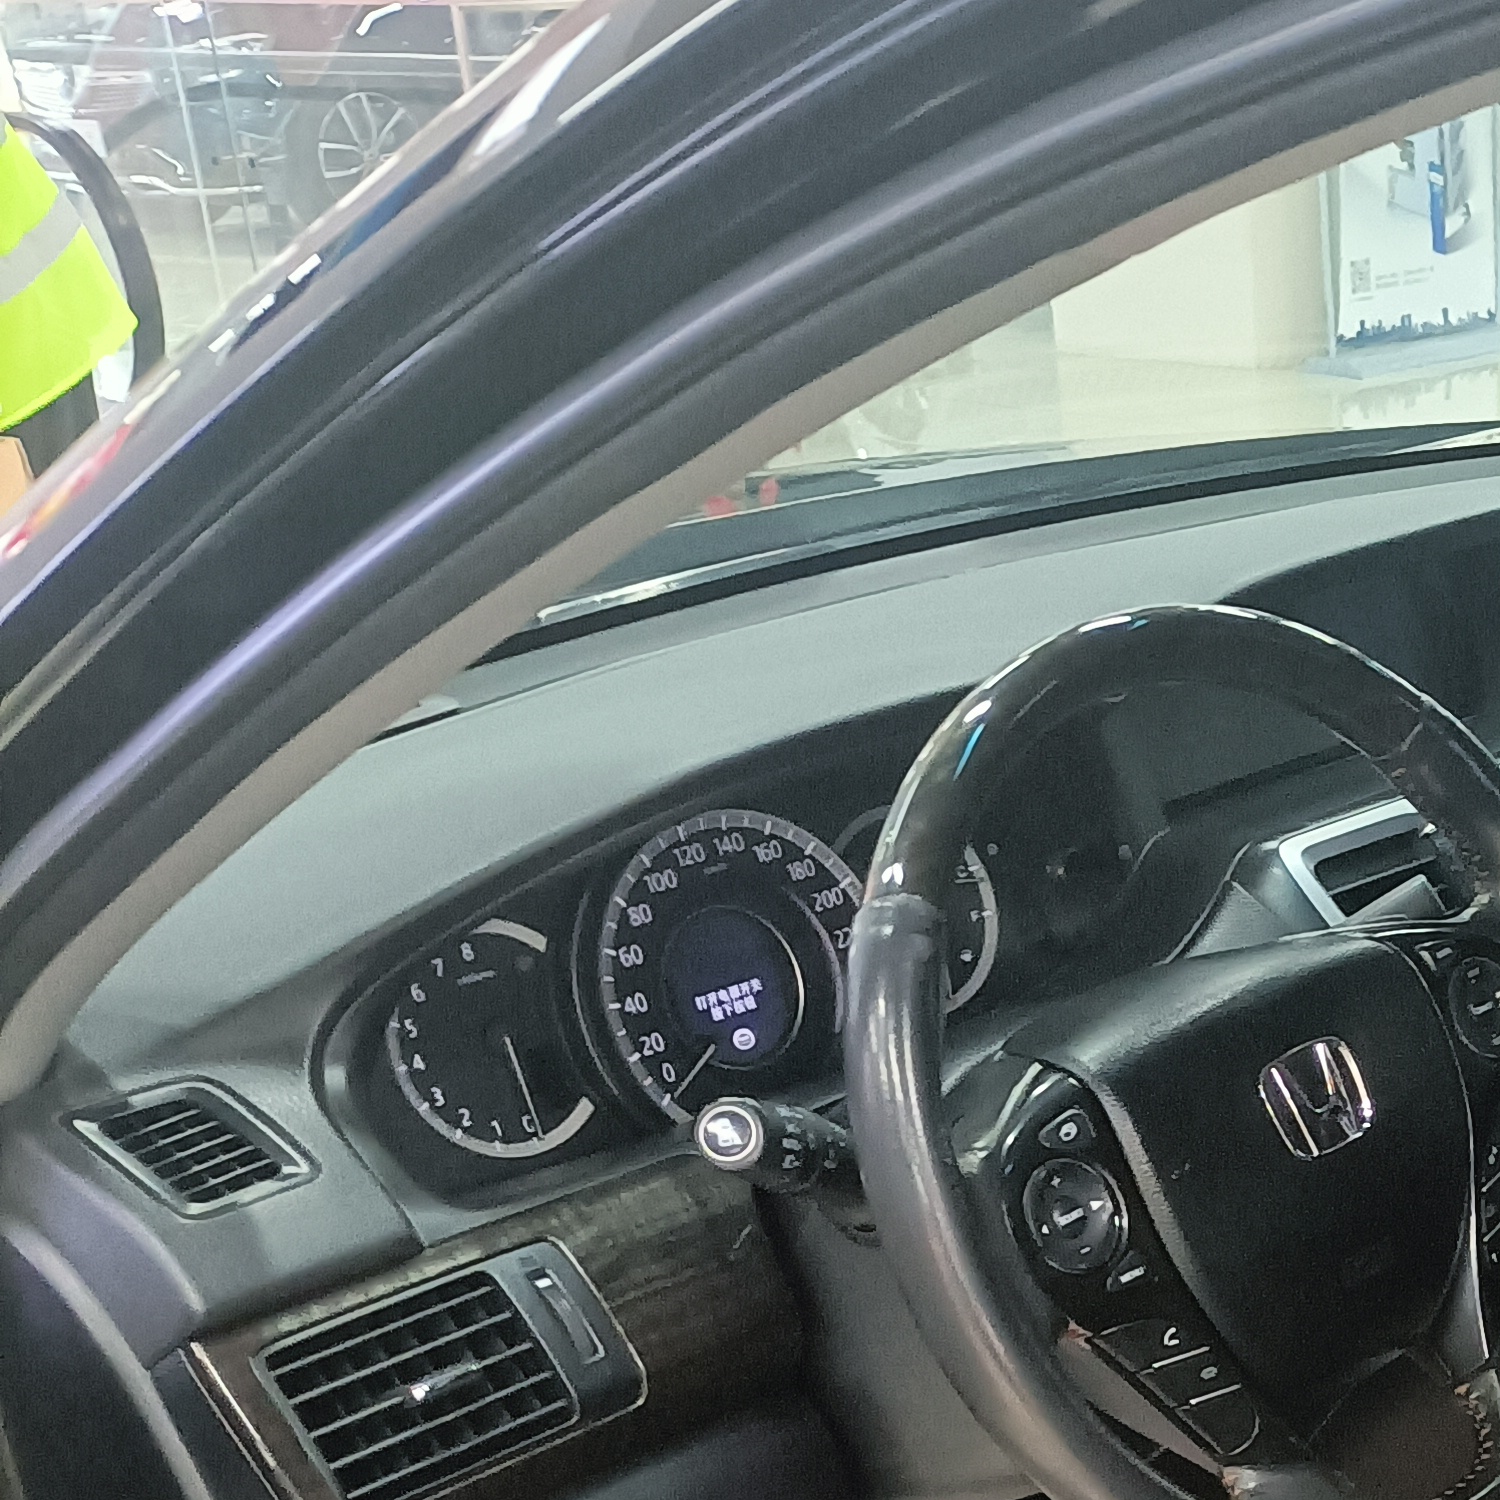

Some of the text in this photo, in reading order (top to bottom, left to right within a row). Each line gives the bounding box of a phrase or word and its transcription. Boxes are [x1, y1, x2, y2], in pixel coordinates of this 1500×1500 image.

[673, 842, 706, 867] 120
[713, 832, 745, 856] 140
[752, 839, 782, 864] 160
[643, 868, 678, 894] 100
[786, 857, 816, 882] 180
[811, 887, 844, 913] 200
[627, 903, 653, 927] 80
[833, 926, 853, 949] 22
[431, 957, 444, 978] 7
[618, 944, 644, 968] 60
[410, 983, 427, 1003] 6
[624, 992, 648, 1014] 40
[404, 1018, 418, 1039] 5
[638, 1031, 665, 1056] 20
[413, 1054, 426, 1071] 4
[661, 1062, 676, 1083] 0
[431, 1086, 446, 1107] 3
[458, 1107, 473, 1127] 2
[490, 1119, 503, 1137] 1
